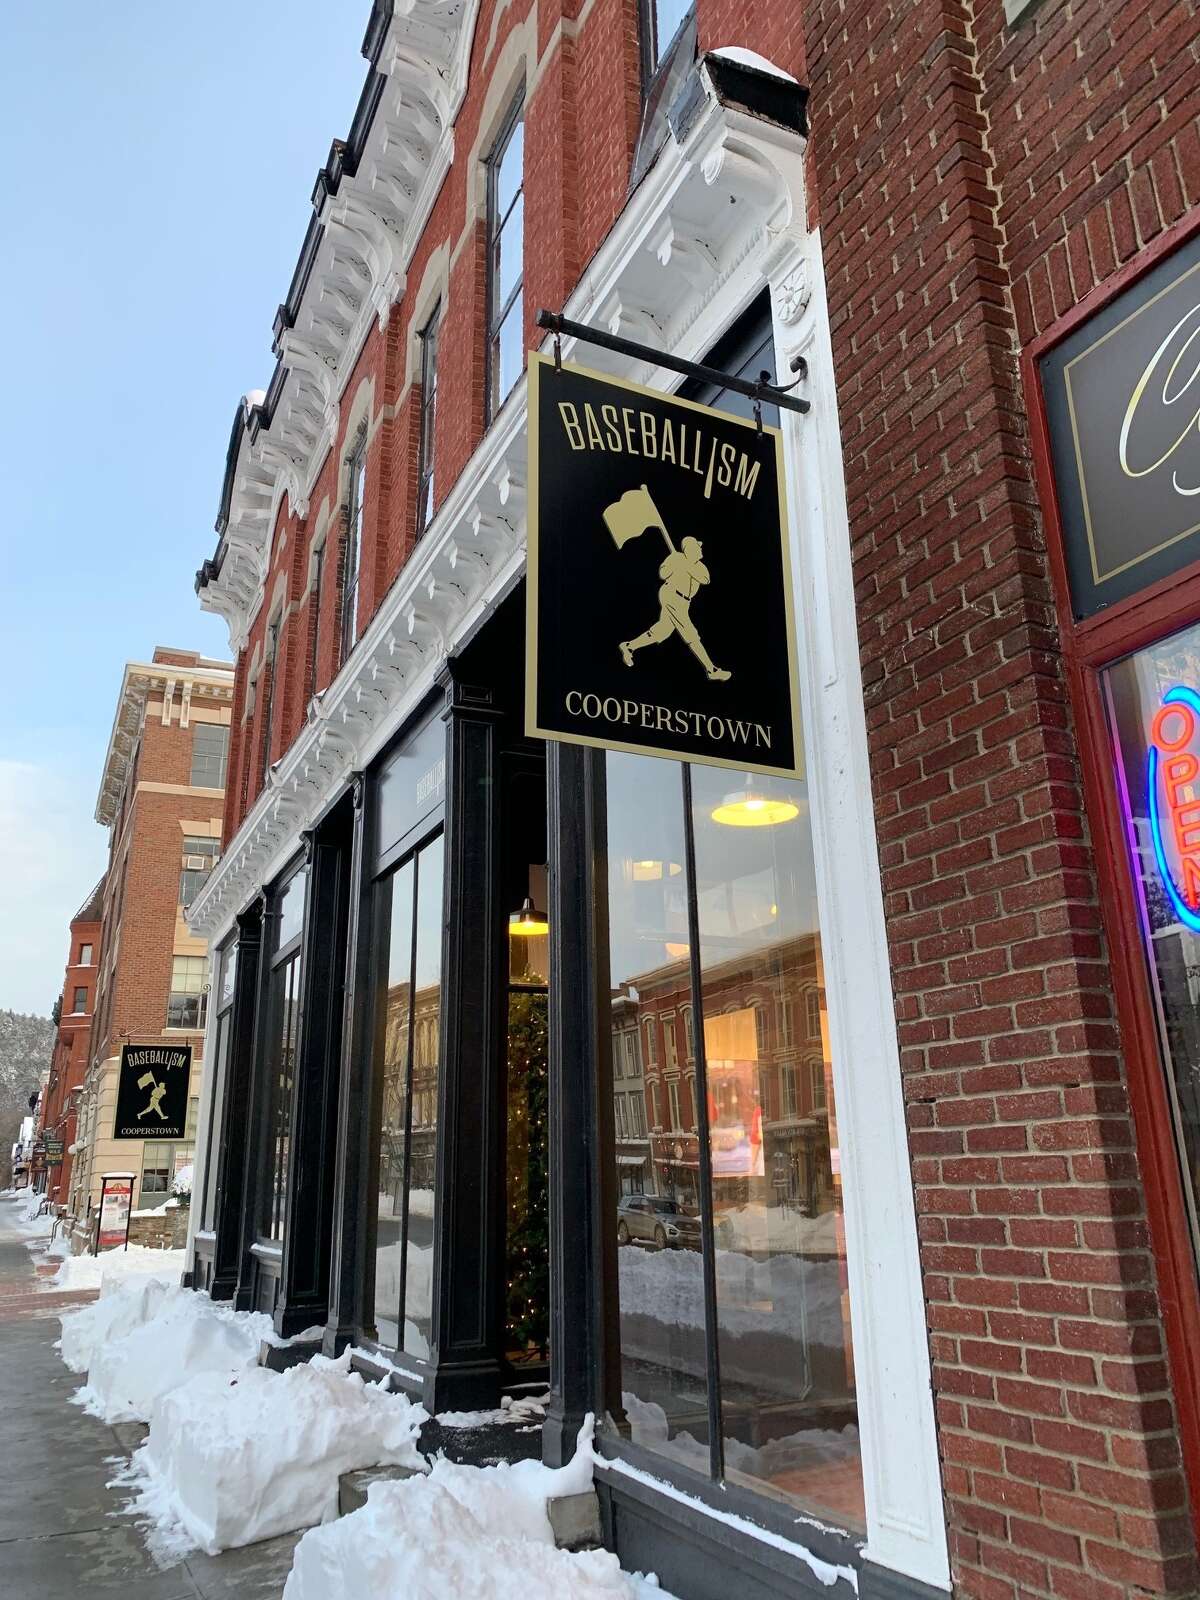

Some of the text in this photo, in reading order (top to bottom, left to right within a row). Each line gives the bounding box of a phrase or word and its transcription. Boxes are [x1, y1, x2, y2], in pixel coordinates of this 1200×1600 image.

[557, 401, 761, 499] BASEBALLISM
[565, 690, 772, 749] COOPERSTOWN
[127, 1050, 187, 1071] BASEBALLISM
[121, 1127, 180, 1135] COOPERSTOWN
